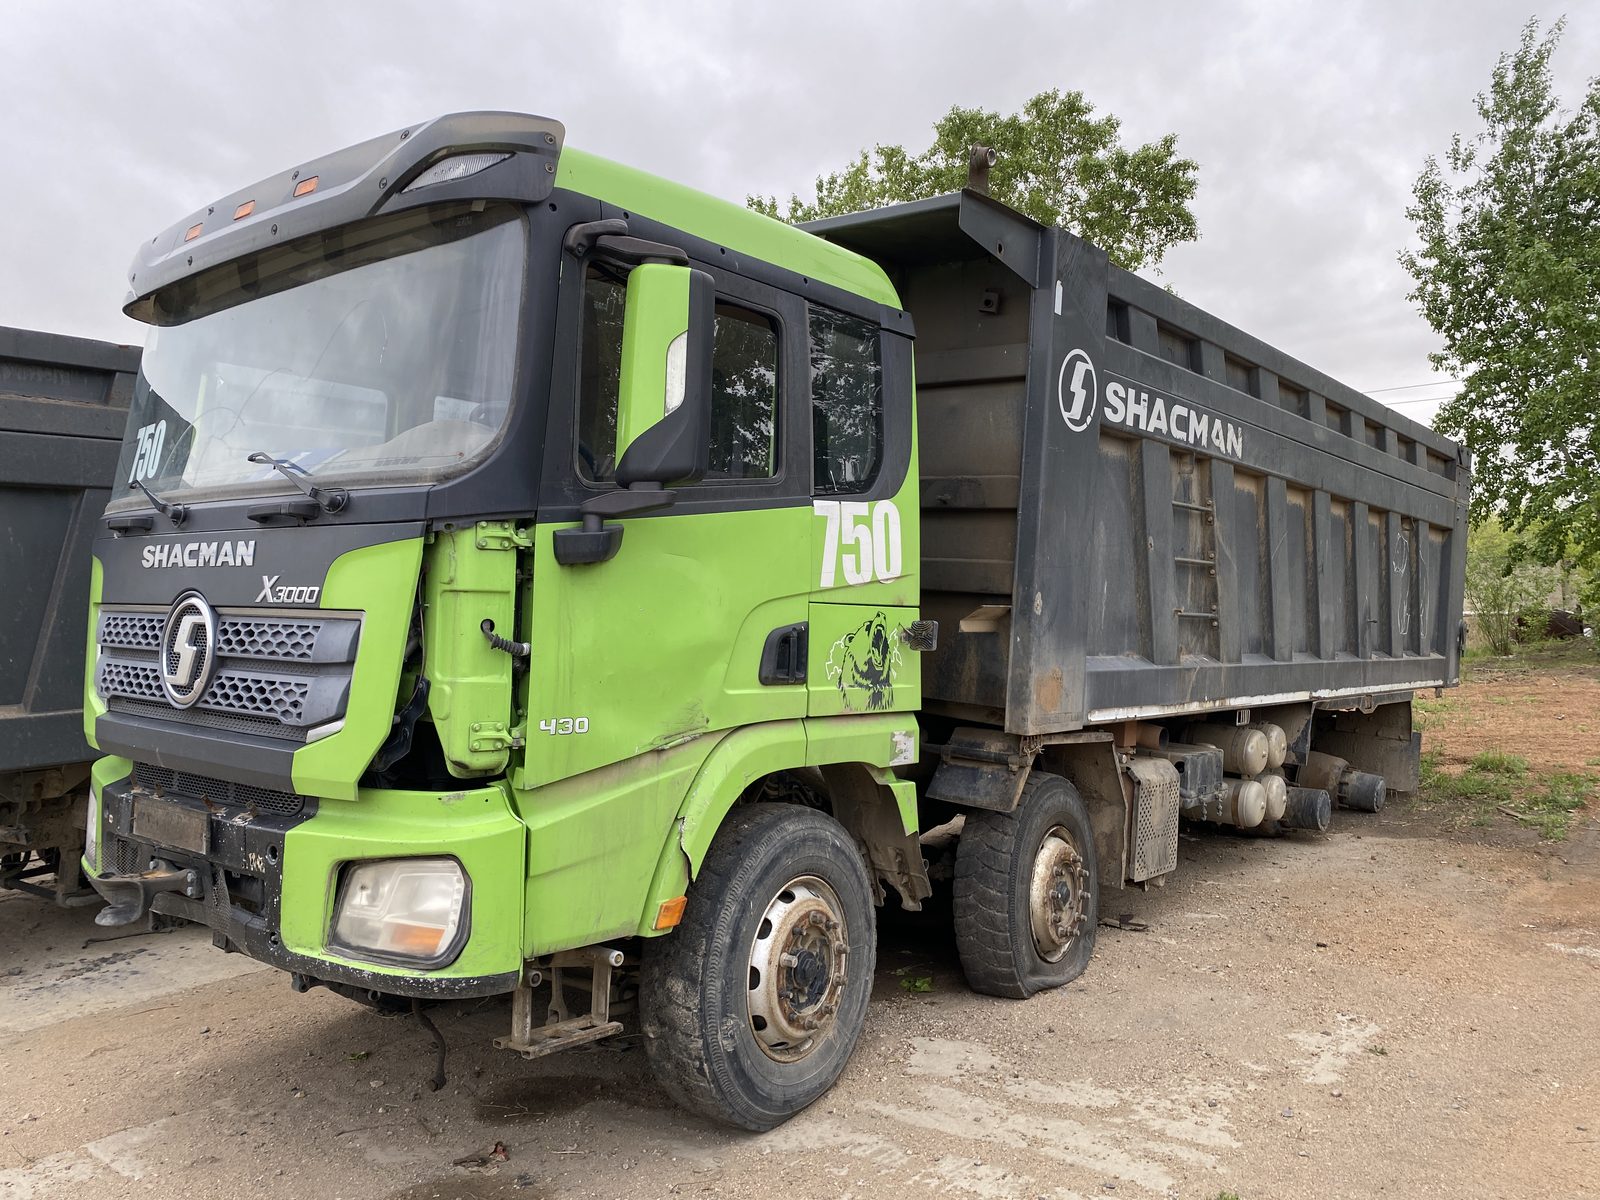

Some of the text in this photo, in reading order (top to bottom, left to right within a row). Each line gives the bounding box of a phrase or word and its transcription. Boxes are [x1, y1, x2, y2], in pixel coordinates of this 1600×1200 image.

[1103, 381, 1243, 459] SHACMAN
[128, 419, 167, 483] 750
[141, 540, 256, 568] SHACMAN
[813, 500, 902, 588] 750
[255, 575, 319, 603] X3000
[539, 717, 589, 735] 430
